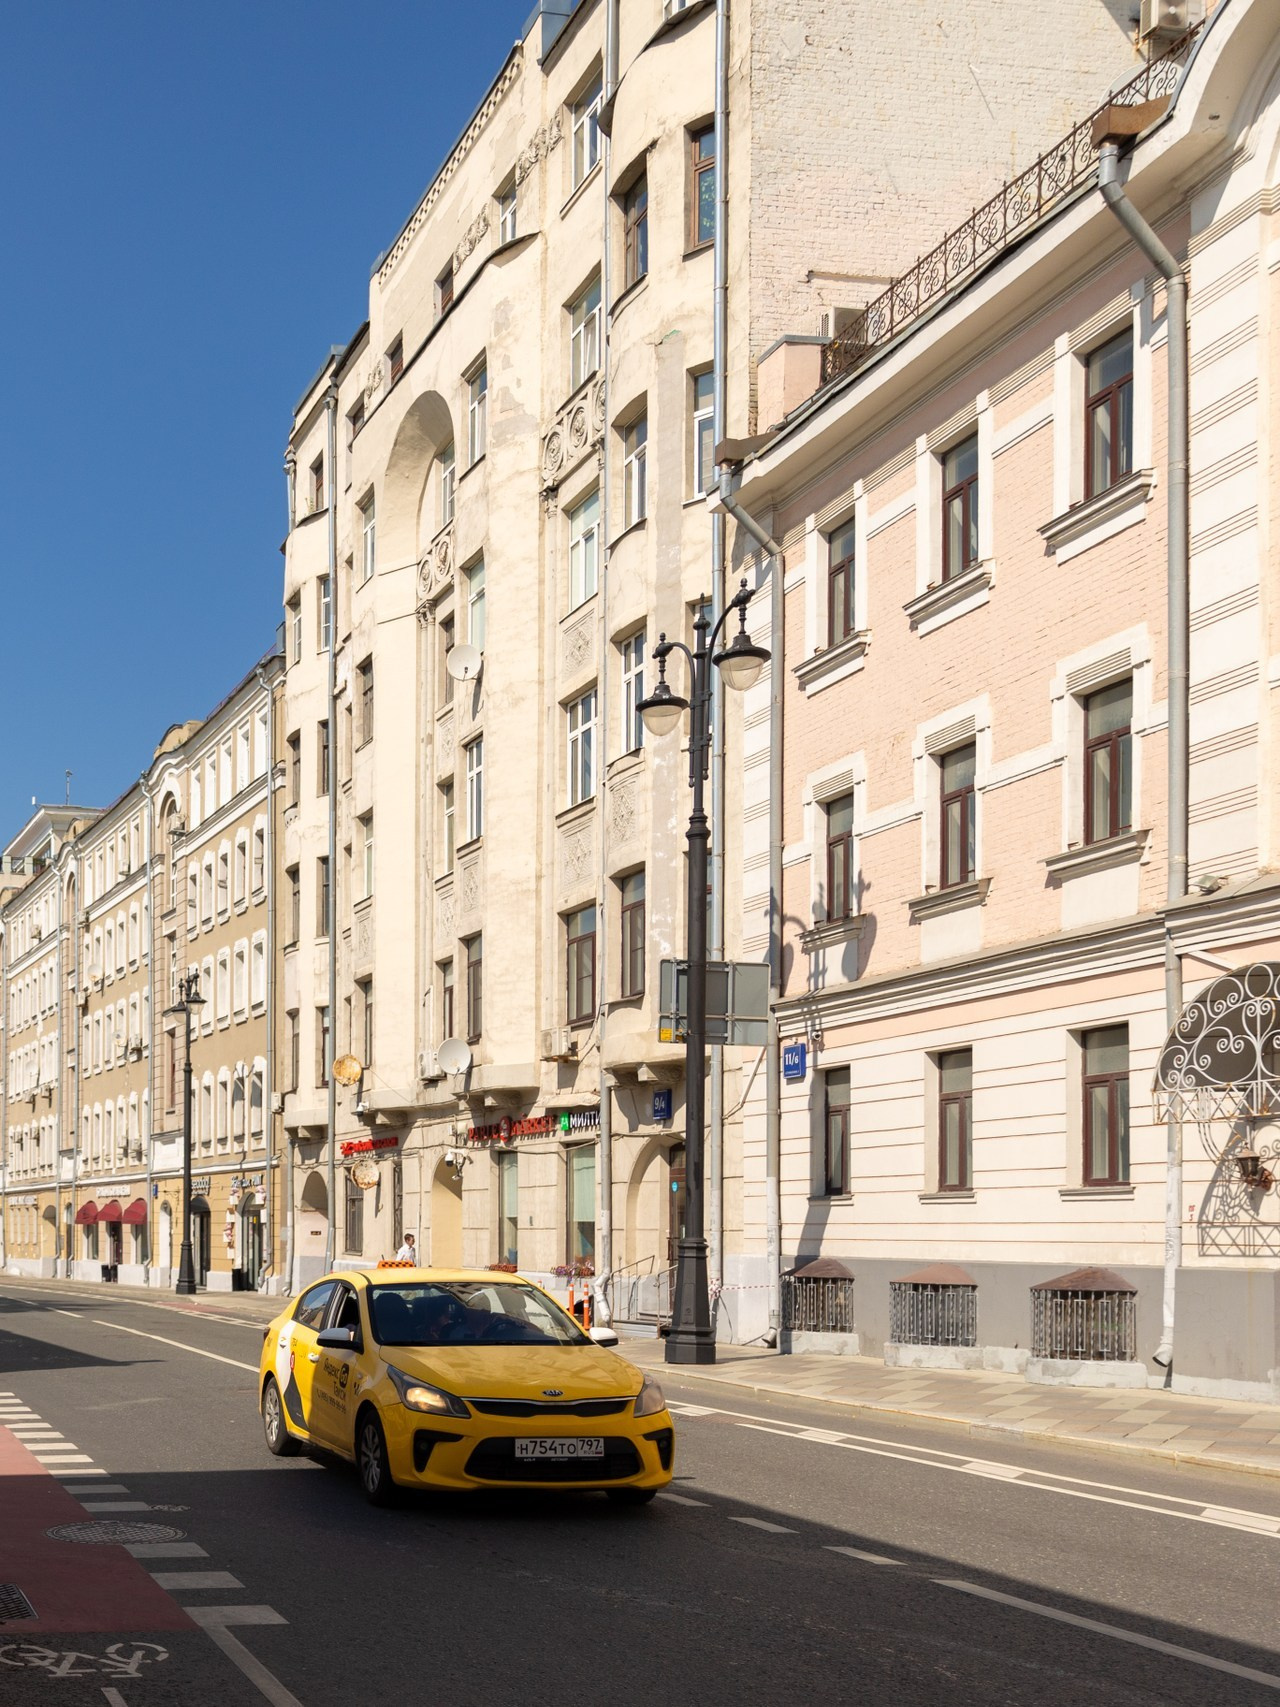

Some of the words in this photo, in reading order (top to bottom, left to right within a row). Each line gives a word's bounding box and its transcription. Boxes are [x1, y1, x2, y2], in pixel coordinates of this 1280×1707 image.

[785, 1052, 799, 1066] 11/6
[520, 1440, 576, 1455] Н754ТО
[579, 1439, 600, 1450] 797
